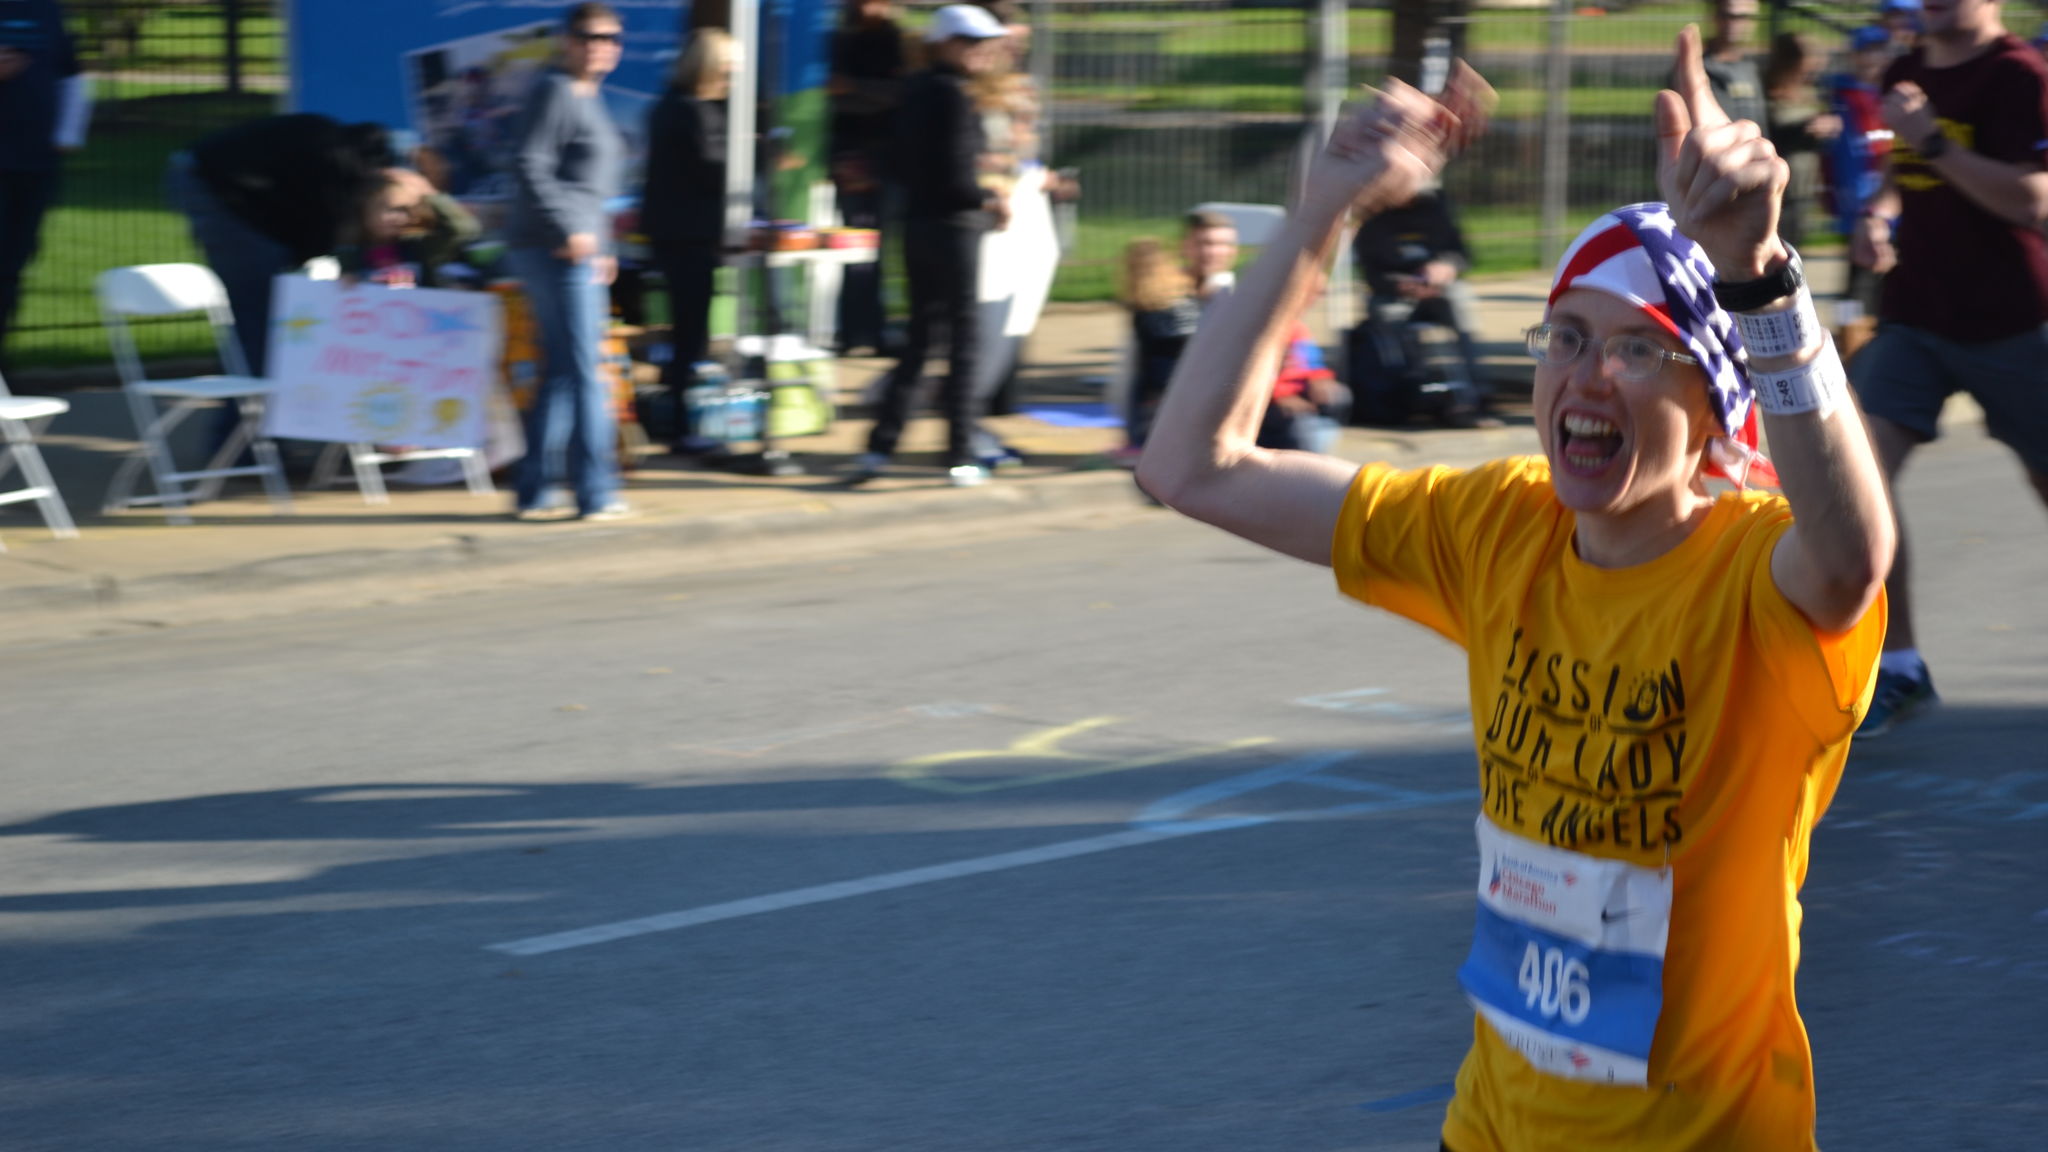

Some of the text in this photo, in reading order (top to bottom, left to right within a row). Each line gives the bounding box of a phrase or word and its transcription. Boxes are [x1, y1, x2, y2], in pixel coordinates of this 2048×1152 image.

[1776, 379, 1794, 407] 2:48
[1574, 731, 1687, 792] LADY
[1483, 759, 1682, 852] THE ANGELS
[1517, 940, 1591, 1027] 406
